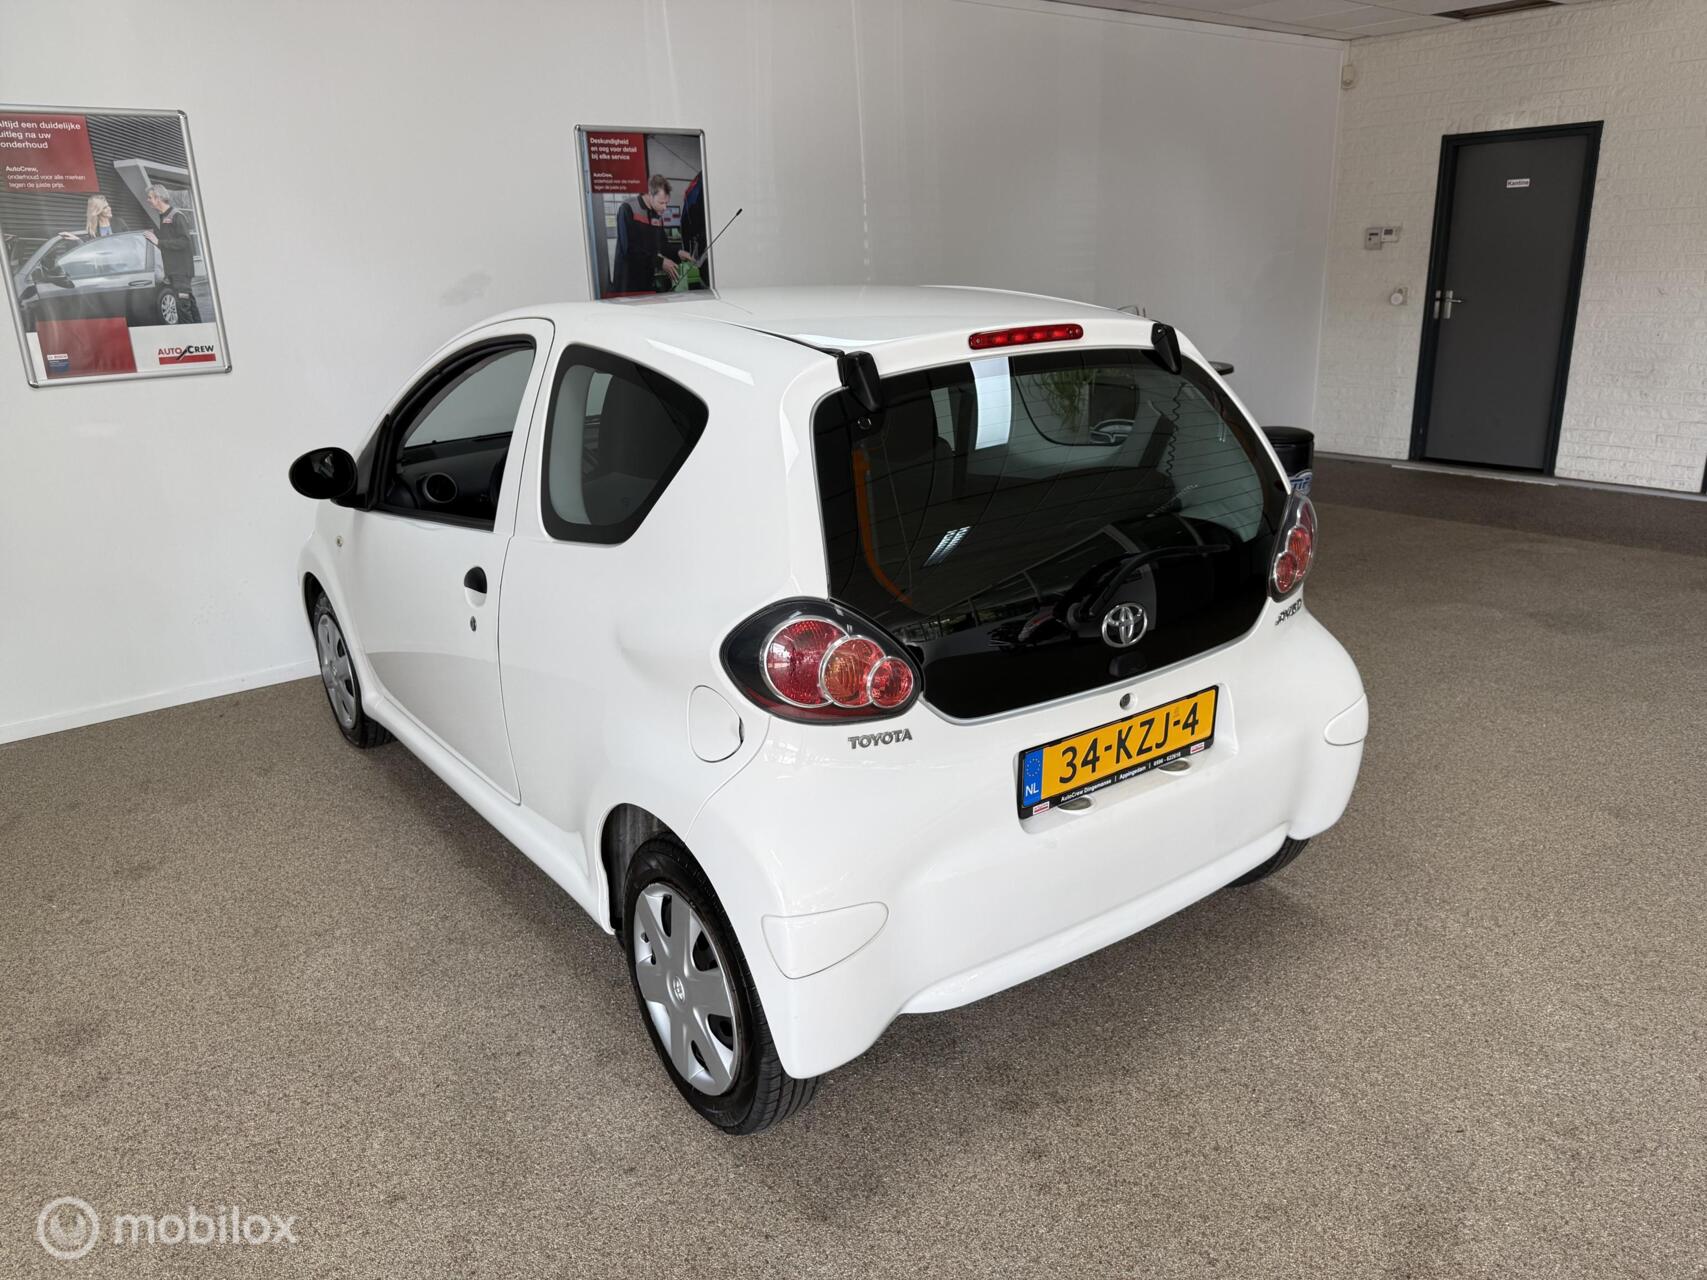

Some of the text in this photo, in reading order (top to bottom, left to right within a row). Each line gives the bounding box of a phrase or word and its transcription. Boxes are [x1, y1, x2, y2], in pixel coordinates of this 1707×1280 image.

[40, 121, 80, 130] duidelijke
[187, 345, 214, 353] CREW
[848, 728, 912, 749] TOYOTA
[1059, 702, 1199, 784] 34-KZJ-4
[1025, 782, 1039, 797] NL
